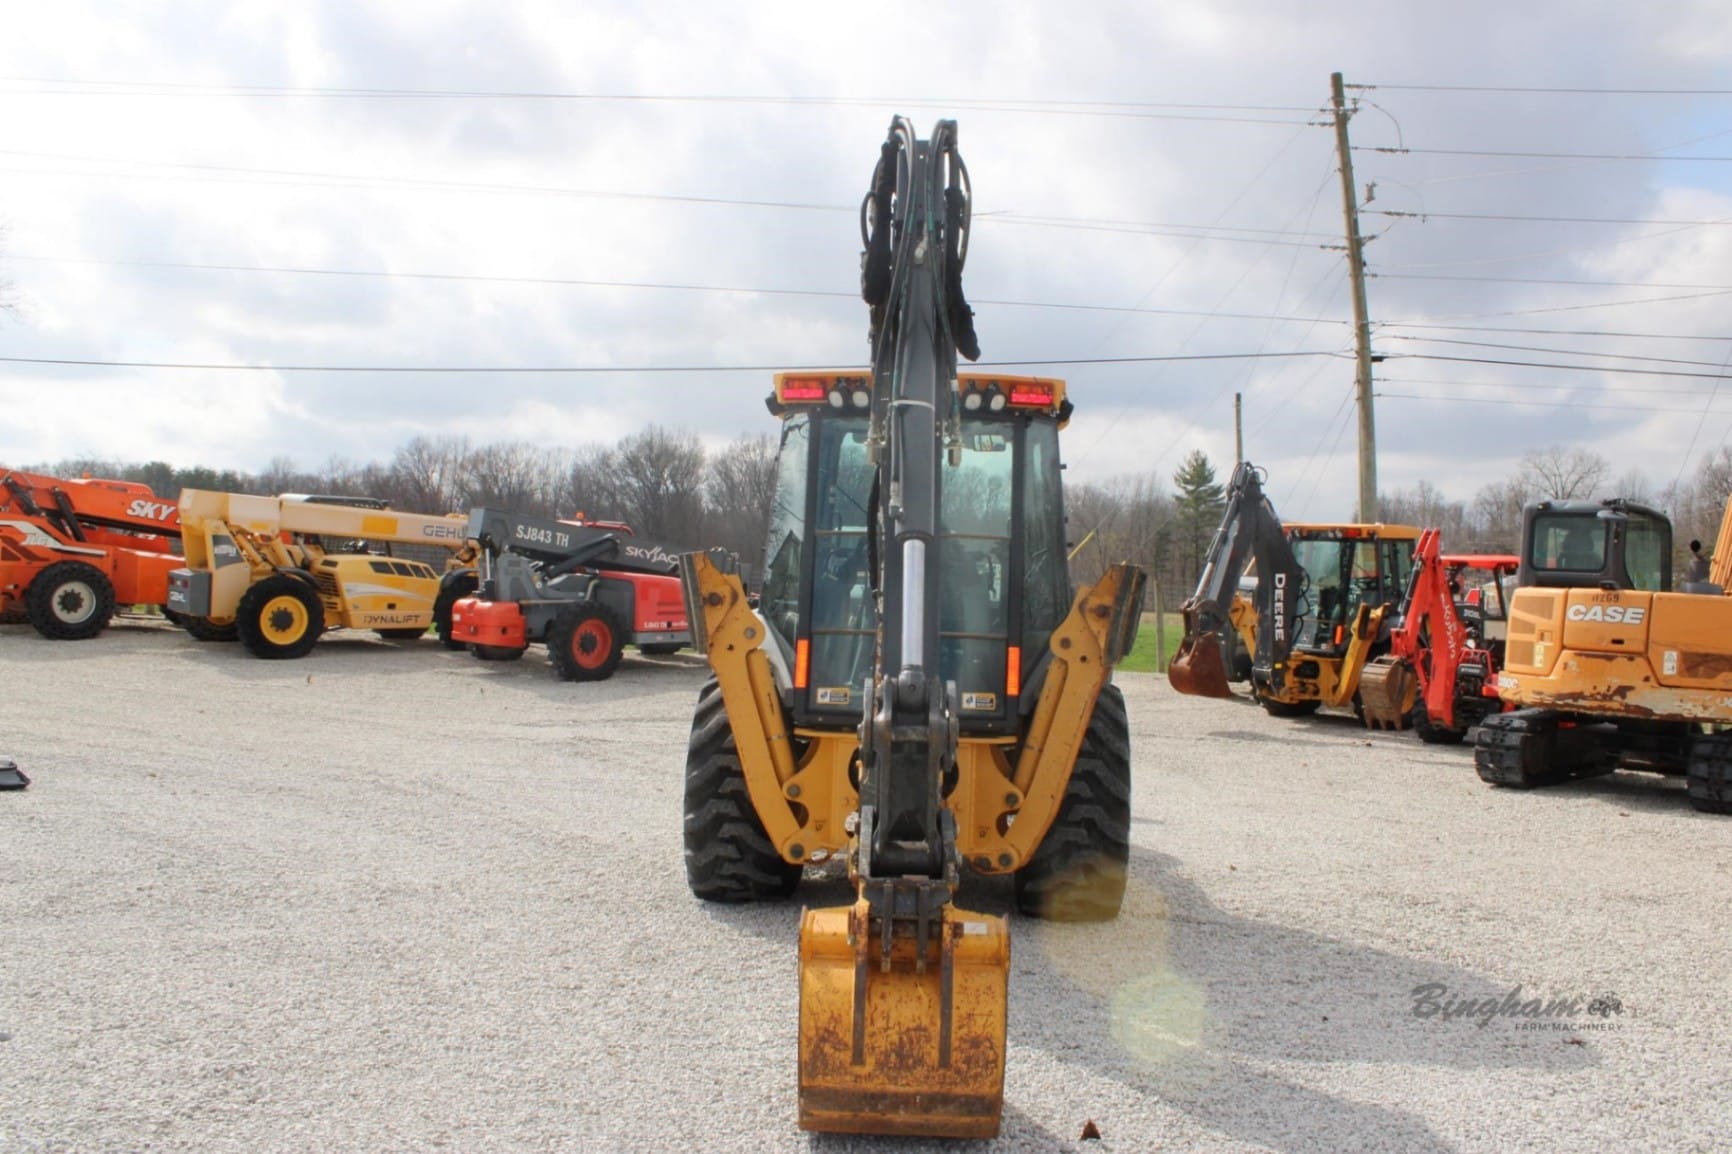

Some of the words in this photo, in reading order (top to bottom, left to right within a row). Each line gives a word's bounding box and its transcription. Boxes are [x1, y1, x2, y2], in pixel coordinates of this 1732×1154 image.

[515, 524, 552, 544] SJ843
[555, 532, 569, 548] TH
[625, 545, 680, 566] SKYJAC
[1274, 572, 1287, 641] DEERE
[1566, 603, 1646, 625] CASE
[363, 614, 420, 625] DYNALIFT
